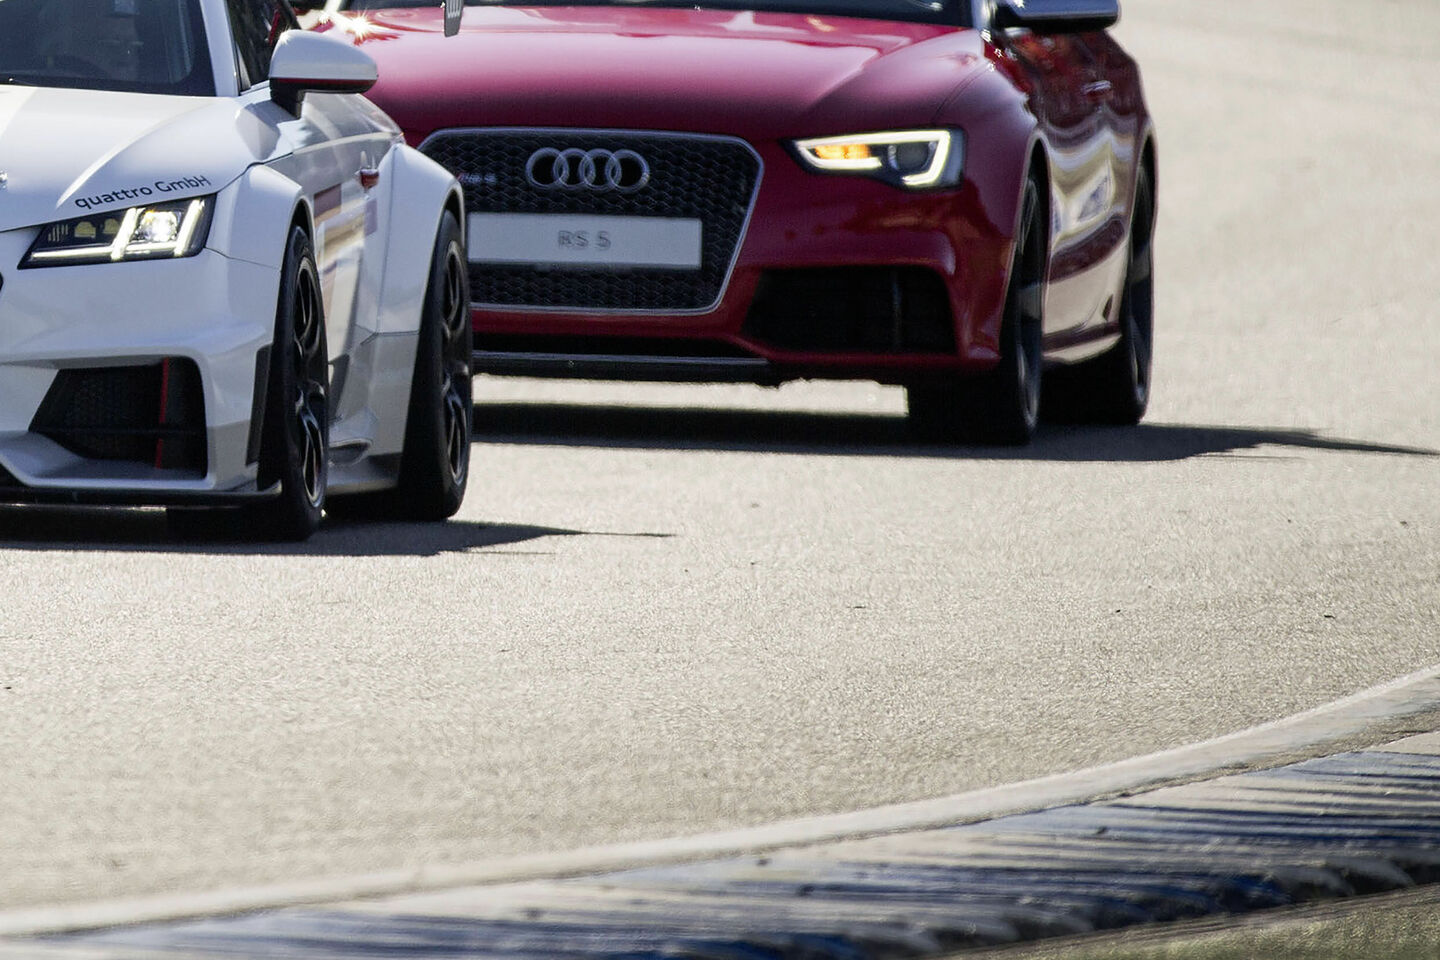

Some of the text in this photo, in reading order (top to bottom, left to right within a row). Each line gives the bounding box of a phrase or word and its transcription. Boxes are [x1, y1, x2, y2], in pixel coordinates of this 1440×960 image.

[75, 174, 212, 210] quattro GmbH
[558, 230, 612, 251] RS 5
